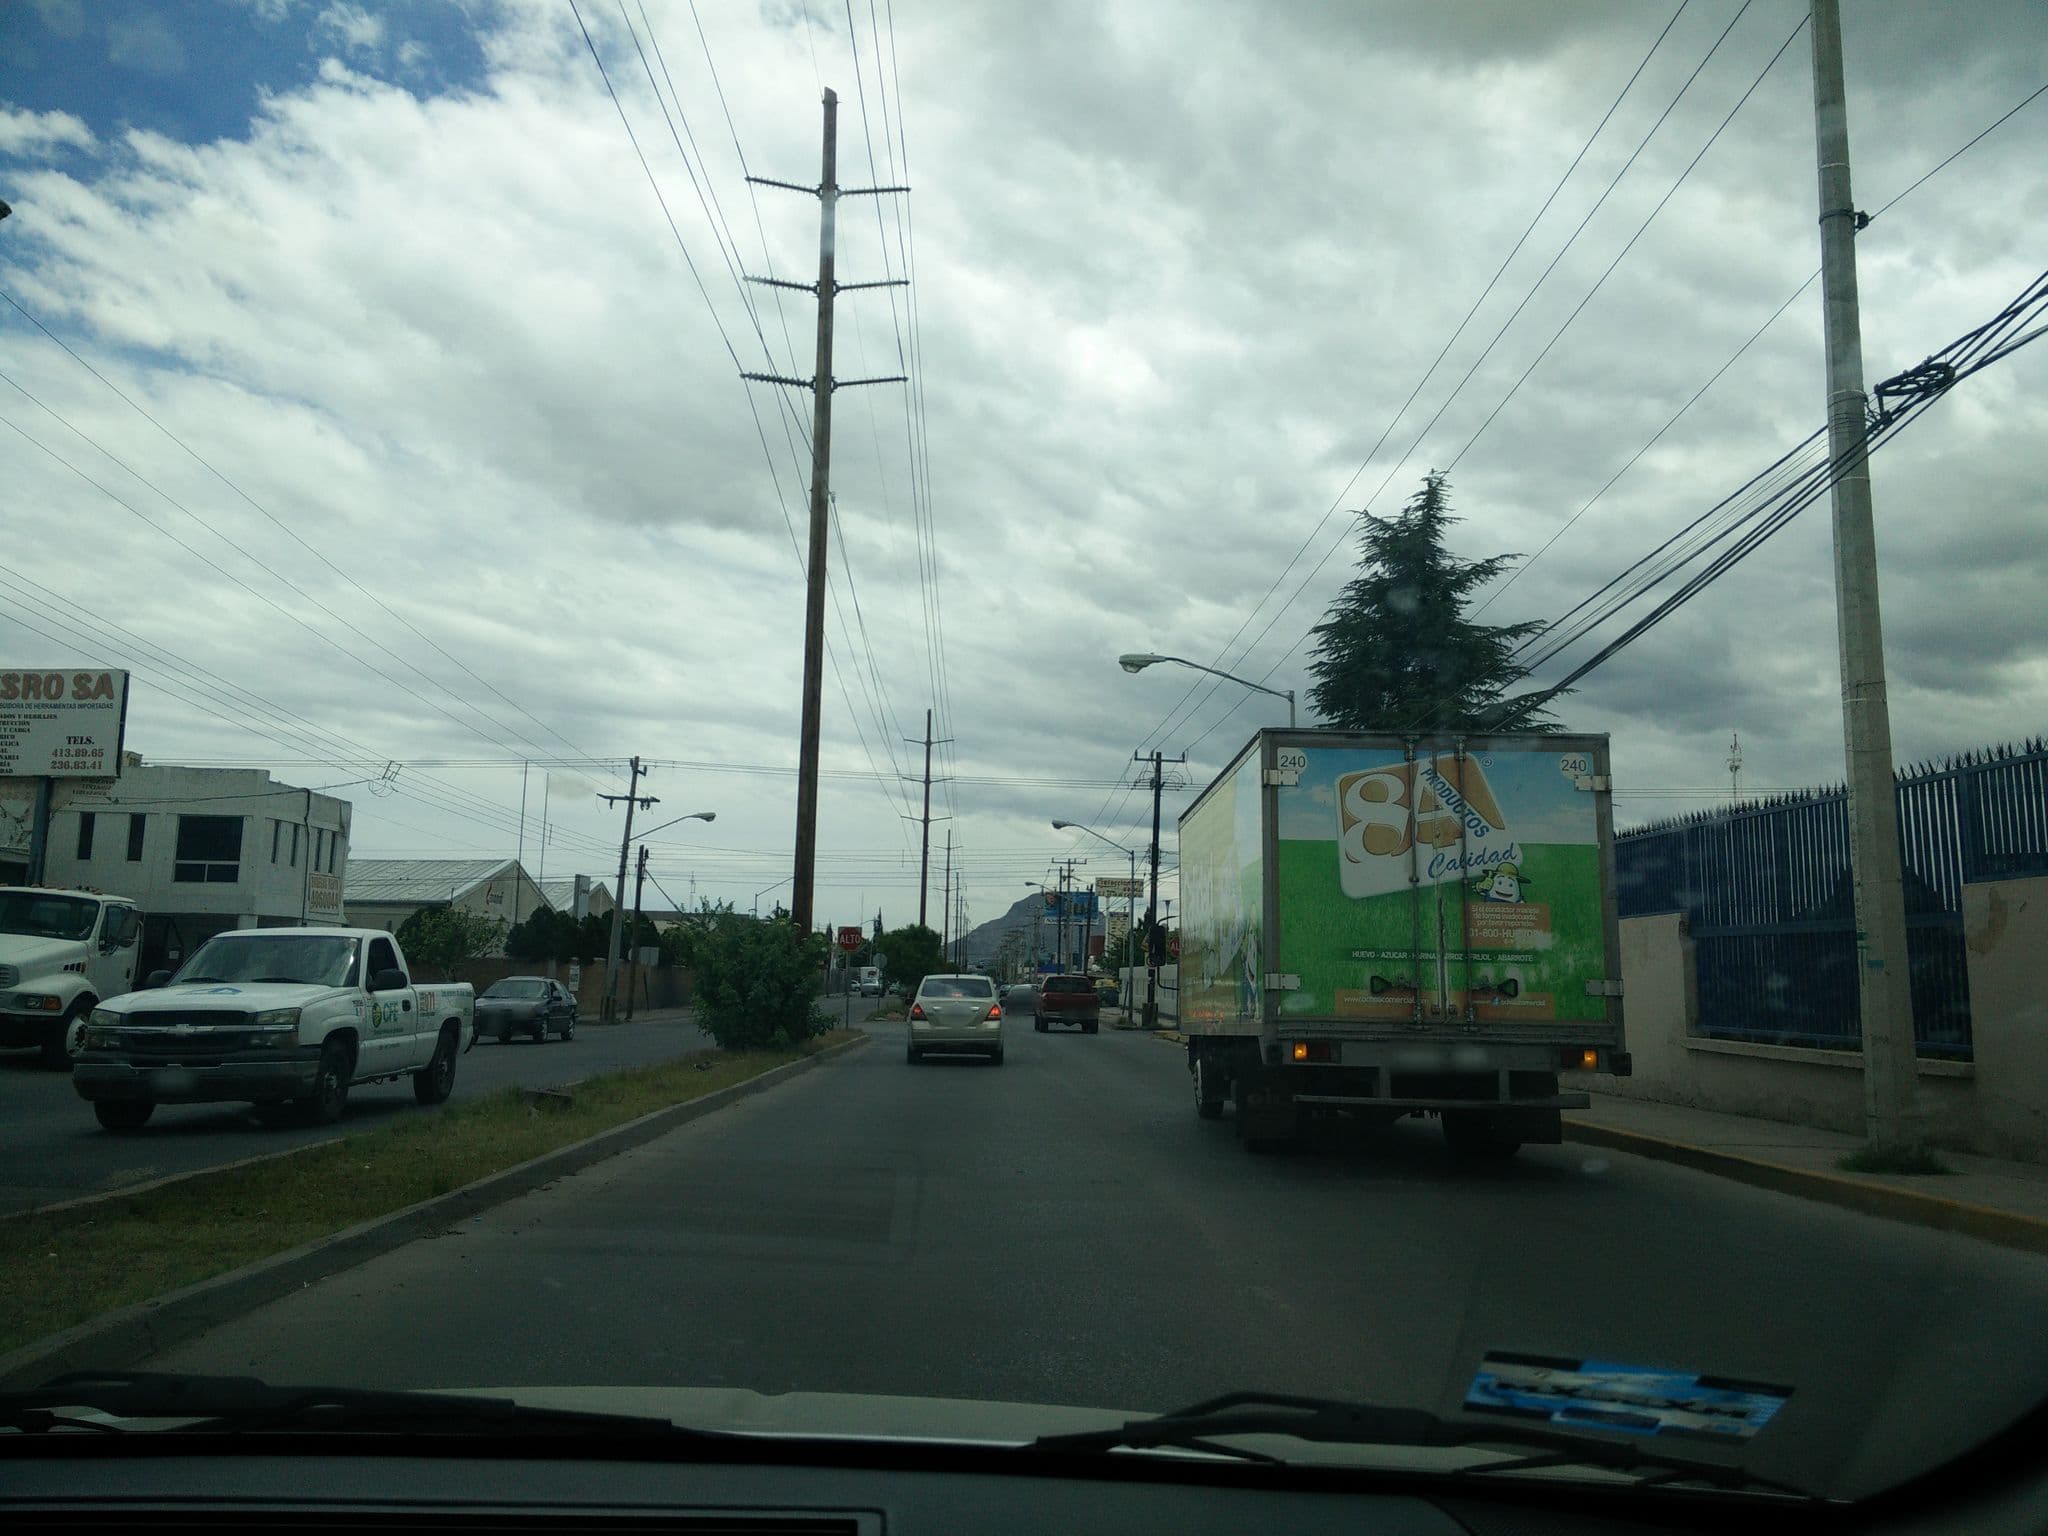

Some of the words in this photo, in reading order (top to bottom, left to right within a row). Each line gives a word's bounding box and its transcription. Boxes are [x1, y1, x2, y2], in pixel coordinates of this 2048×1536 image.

[72, 672, 114, 700] SA
[66, 735, 95, 745] TELS.
[1280, 755, 1306, 768] 240
[1561, 759, 1587, 772] 240
[1420, 767, 1490, 838] PRODUCTOS
[1427, 842, 1518, 879] Calidad
[840, 934, 861, 944] ALTO
[1352, 950, 1375, 958] HUEVO
[1411, 952, 1436, 960] HRINA
